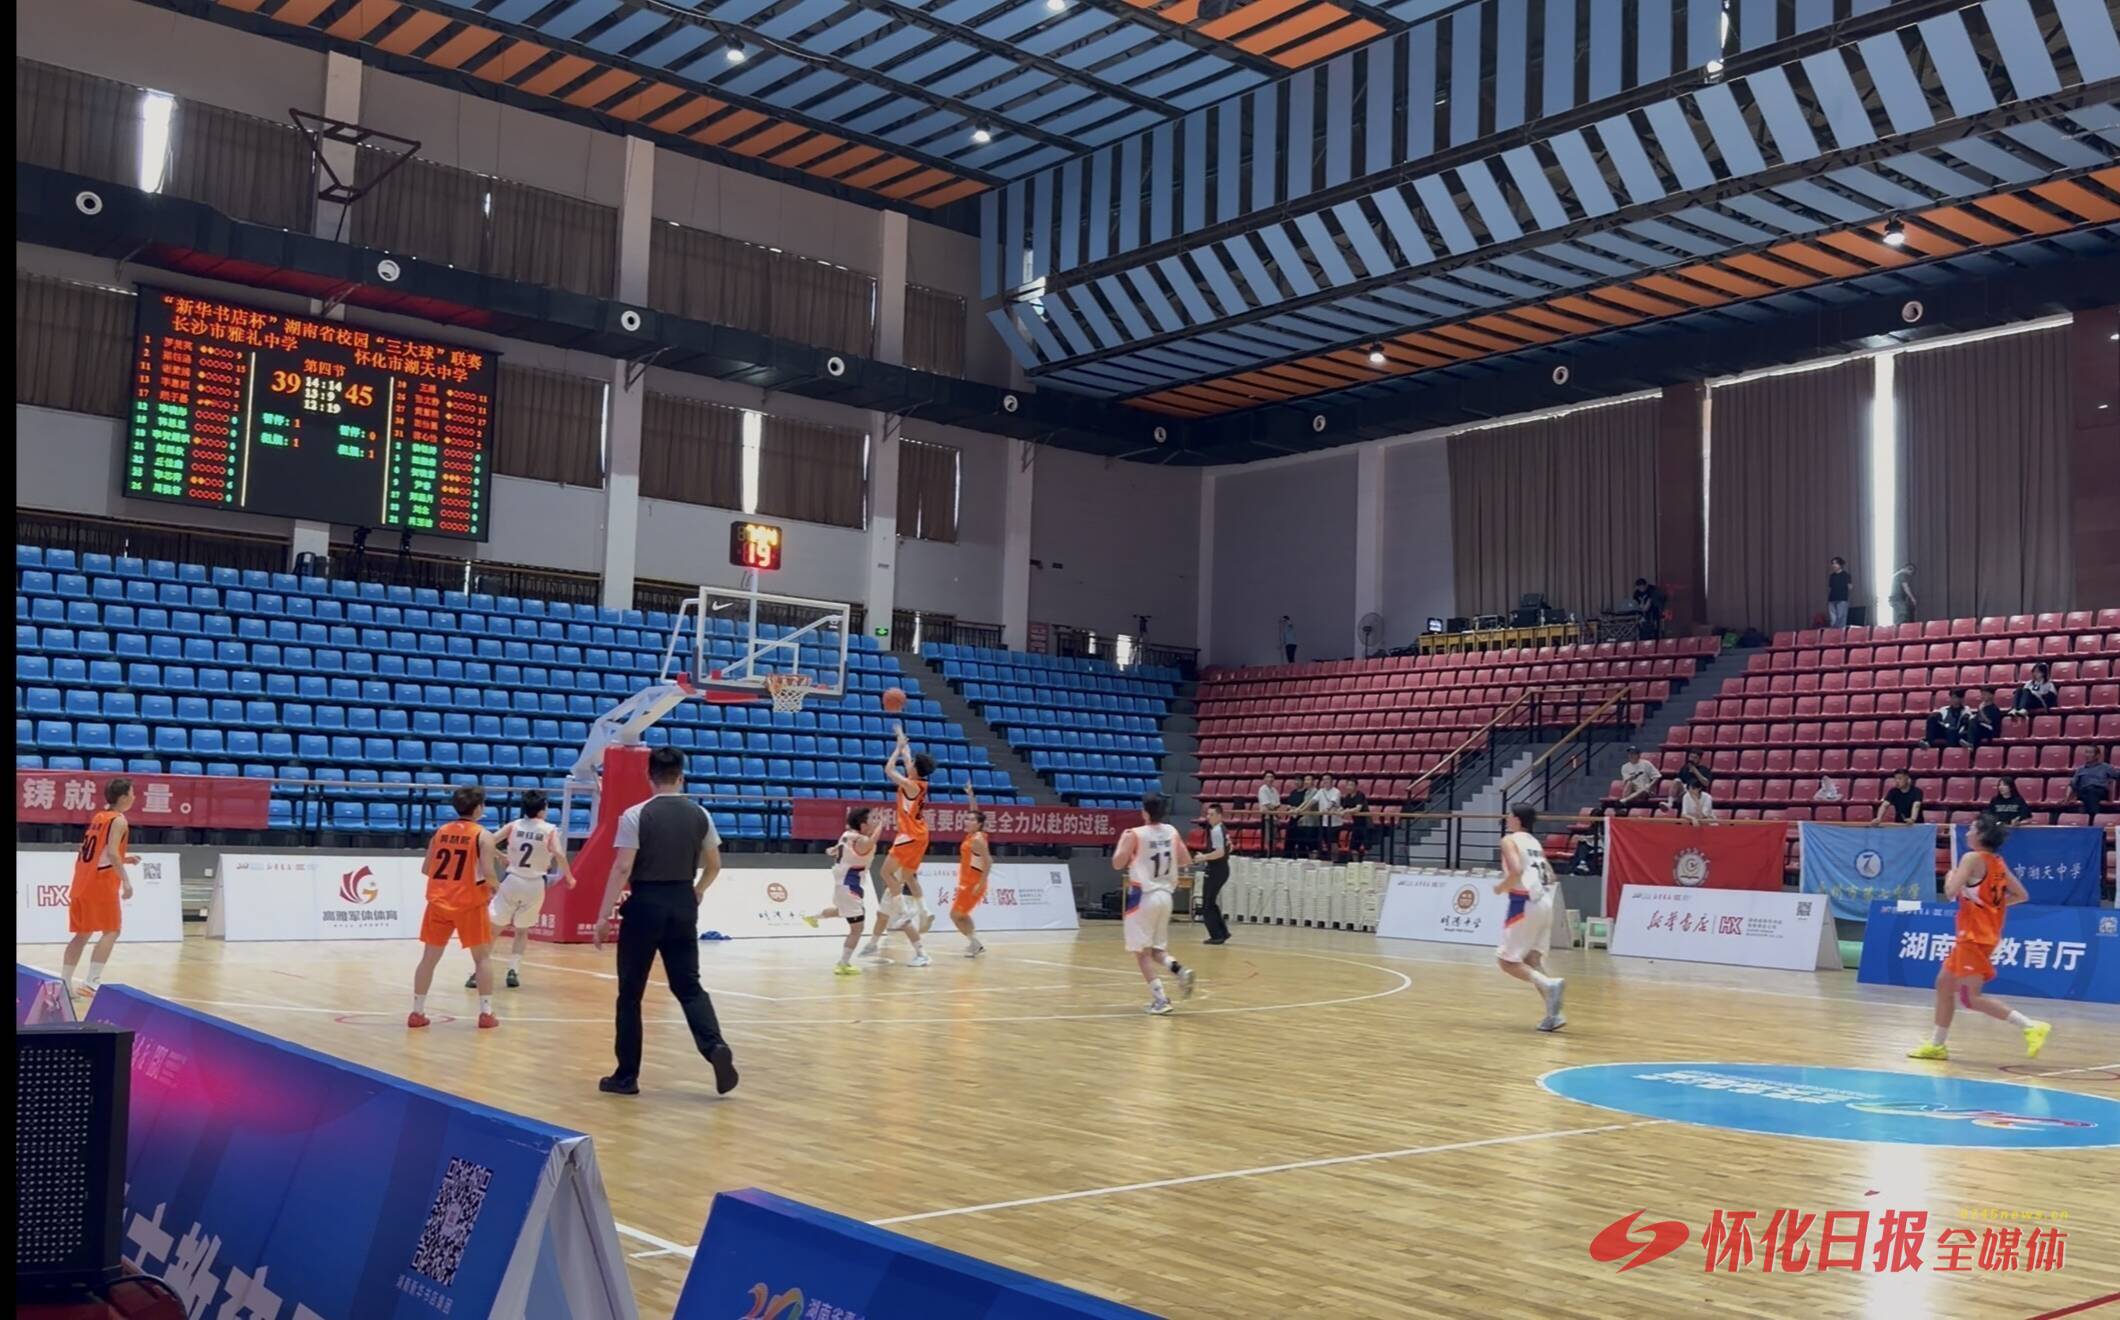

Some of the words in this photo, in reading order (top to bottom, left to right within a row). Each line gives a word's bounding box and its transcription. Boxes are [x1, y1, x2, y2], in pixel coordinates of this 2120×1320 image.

[172, 316, 298, 352] 长沙市雅礼中学
[303, 358, 346, 378] 第四节
[354, 349, 468, 383] 怀化市湖天中学
[271, 370, 302, 394] 39
[305, 376, 342, 392] 14:14
[304, 388, 336, 402] 13:9
[344, 383, 374, 407] 45
[304, 399, 342, 414] 12:19
[294, 418, 300, 428] 1
[292, 438, 300, 448] 1
[369, 431, 376, 440] 0
[368, 450, 375, 459] 1
[748, 542, 770, 567] 19
[23, 778, 192, 814] 铸就量。
[432, 848, 468, 881] 27
[518, 842, 533, 868] 2
[38, 885, 72, 906] HX
[1719, 916, 1744, 935] HX
[1899, 931, 2087, 971] 湖南教育厅
